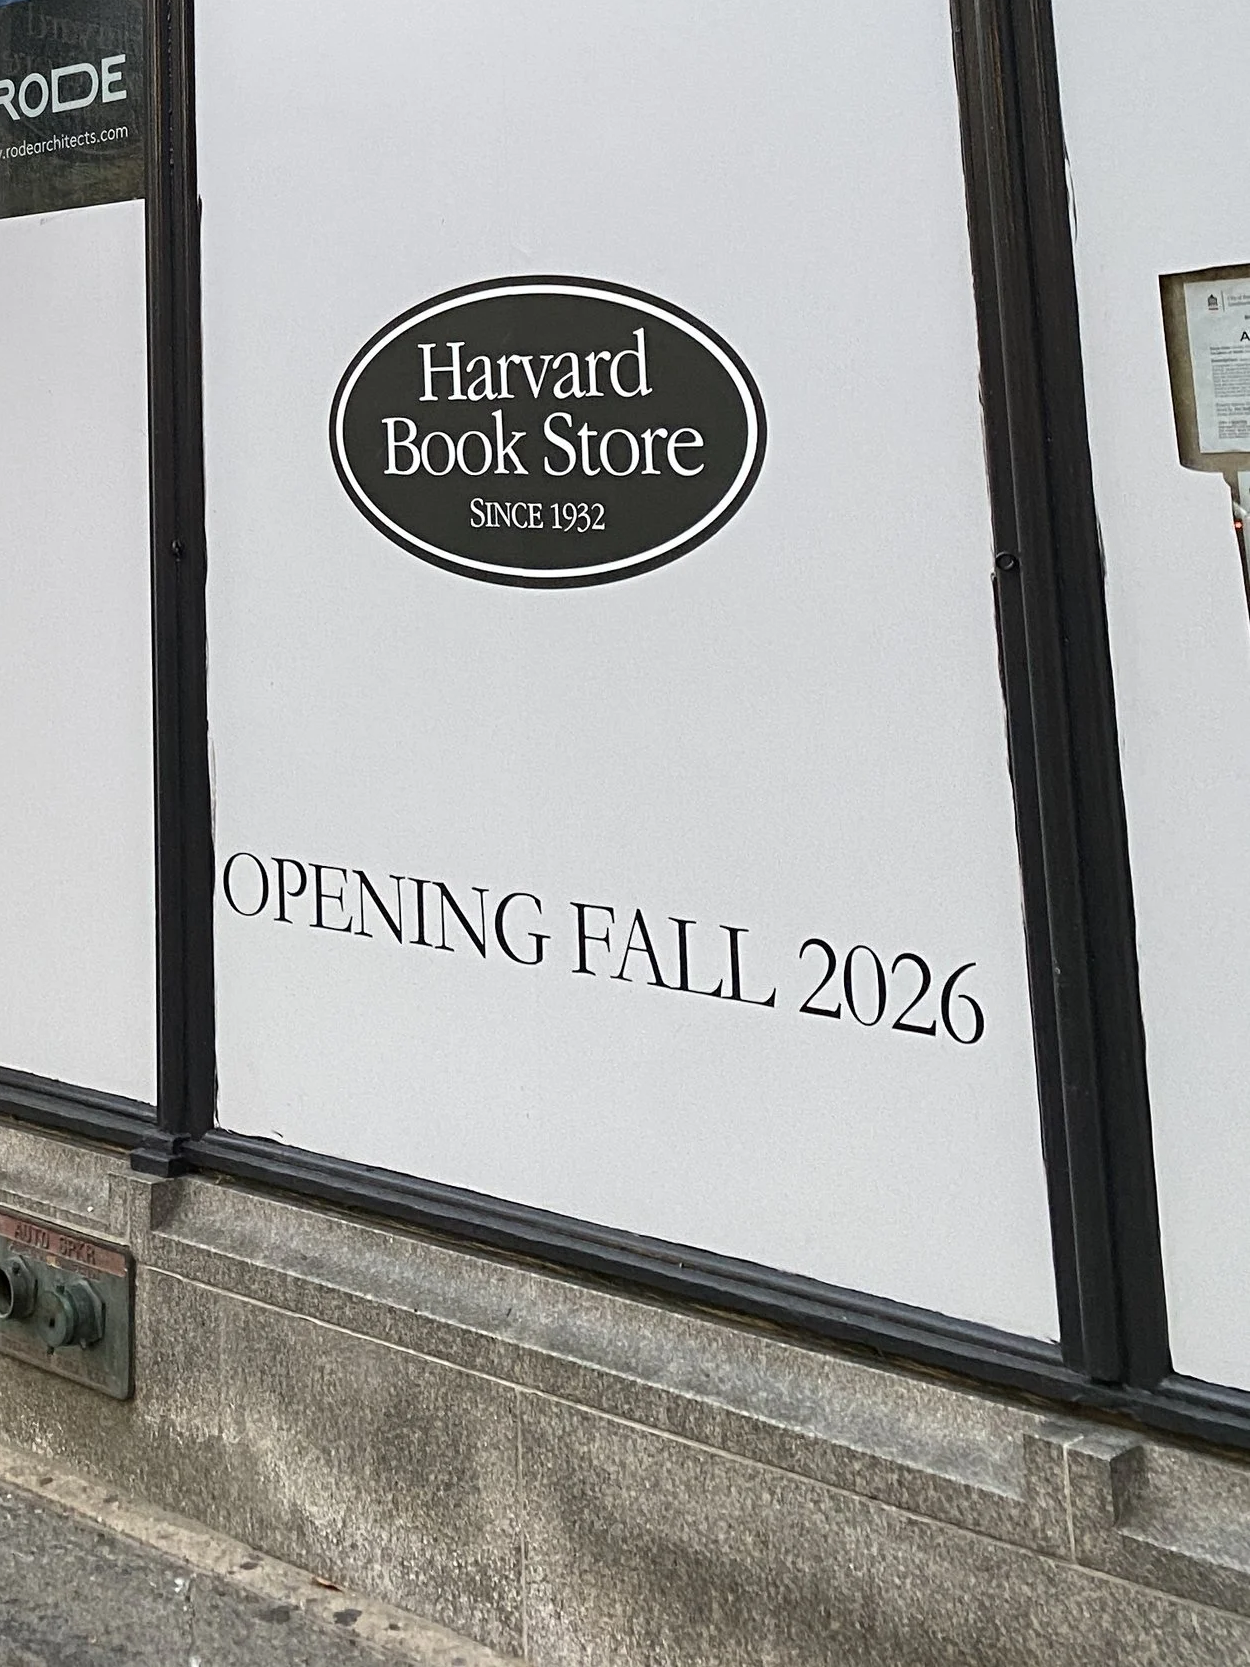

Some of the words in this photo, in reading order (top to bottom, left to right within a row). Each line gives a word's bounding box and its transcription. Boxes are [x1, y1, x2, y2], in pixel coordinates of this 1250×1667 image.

[417, 327, 653, 402] Harvard
[381, 408, 529, 477] Book
[542, 411, 705, 477] Store
[469, 498, 544, 529] SINCE
[549, 502, 606, 533] 1932
[222, 851, 552, 966] OPENING
[570, 900, 777, 1008] FALL
[798, 938, 986, 1046] 2026
